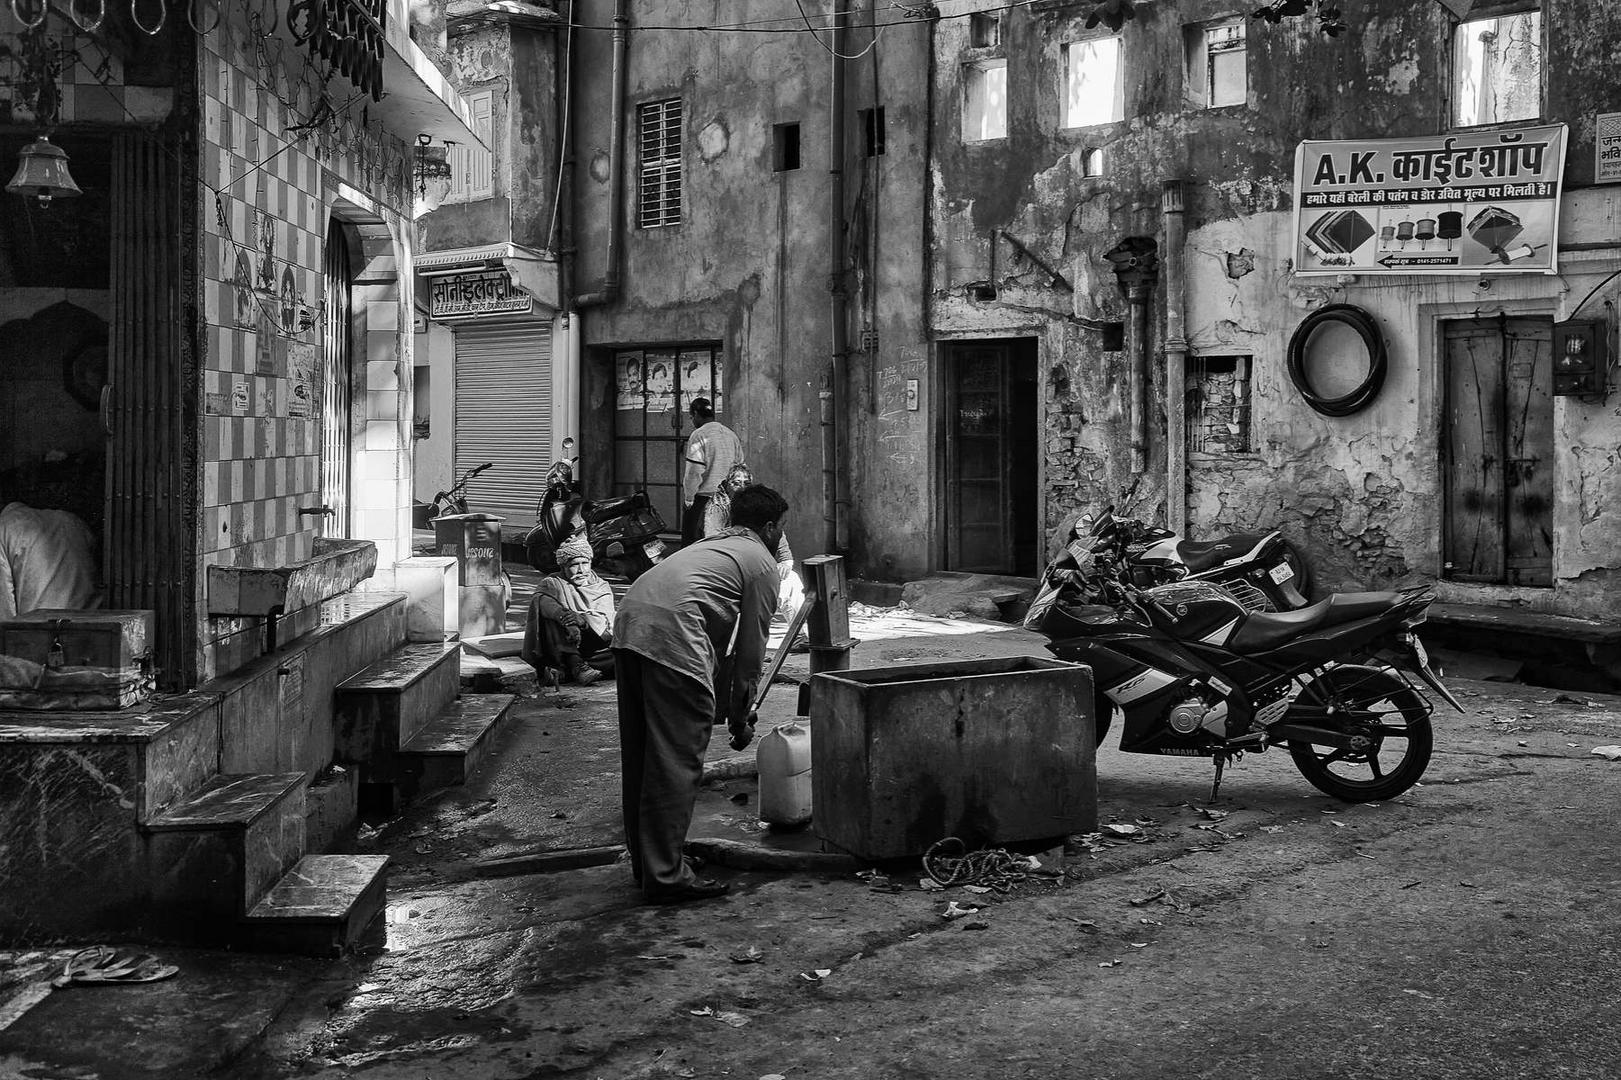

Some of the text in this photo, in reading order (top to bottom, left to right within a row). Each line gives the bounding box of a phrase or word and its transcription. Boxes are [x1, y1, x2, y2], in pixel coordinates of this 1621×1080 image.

[1313, 151, 1384, 186] A.K.
[1306, 193, 1327, 204] हमारे
[1347, 190, 1370, 202] बरेली
[1372, 189, 1385, 201] की
[1388, 189, 1409, 201] पतंग
[1411, 191, 1418, 200] व
[1420, 188, 1436, 200] डोर
[1438, 187, 1461, 199] उचित
[1464, 187, 1486, 202] मूल्य
[1488, 187, 1501, 197] पर
[1503, 183, 1536, 196] मिलती
[1160, 748, 1199, 756] YAMAHA
